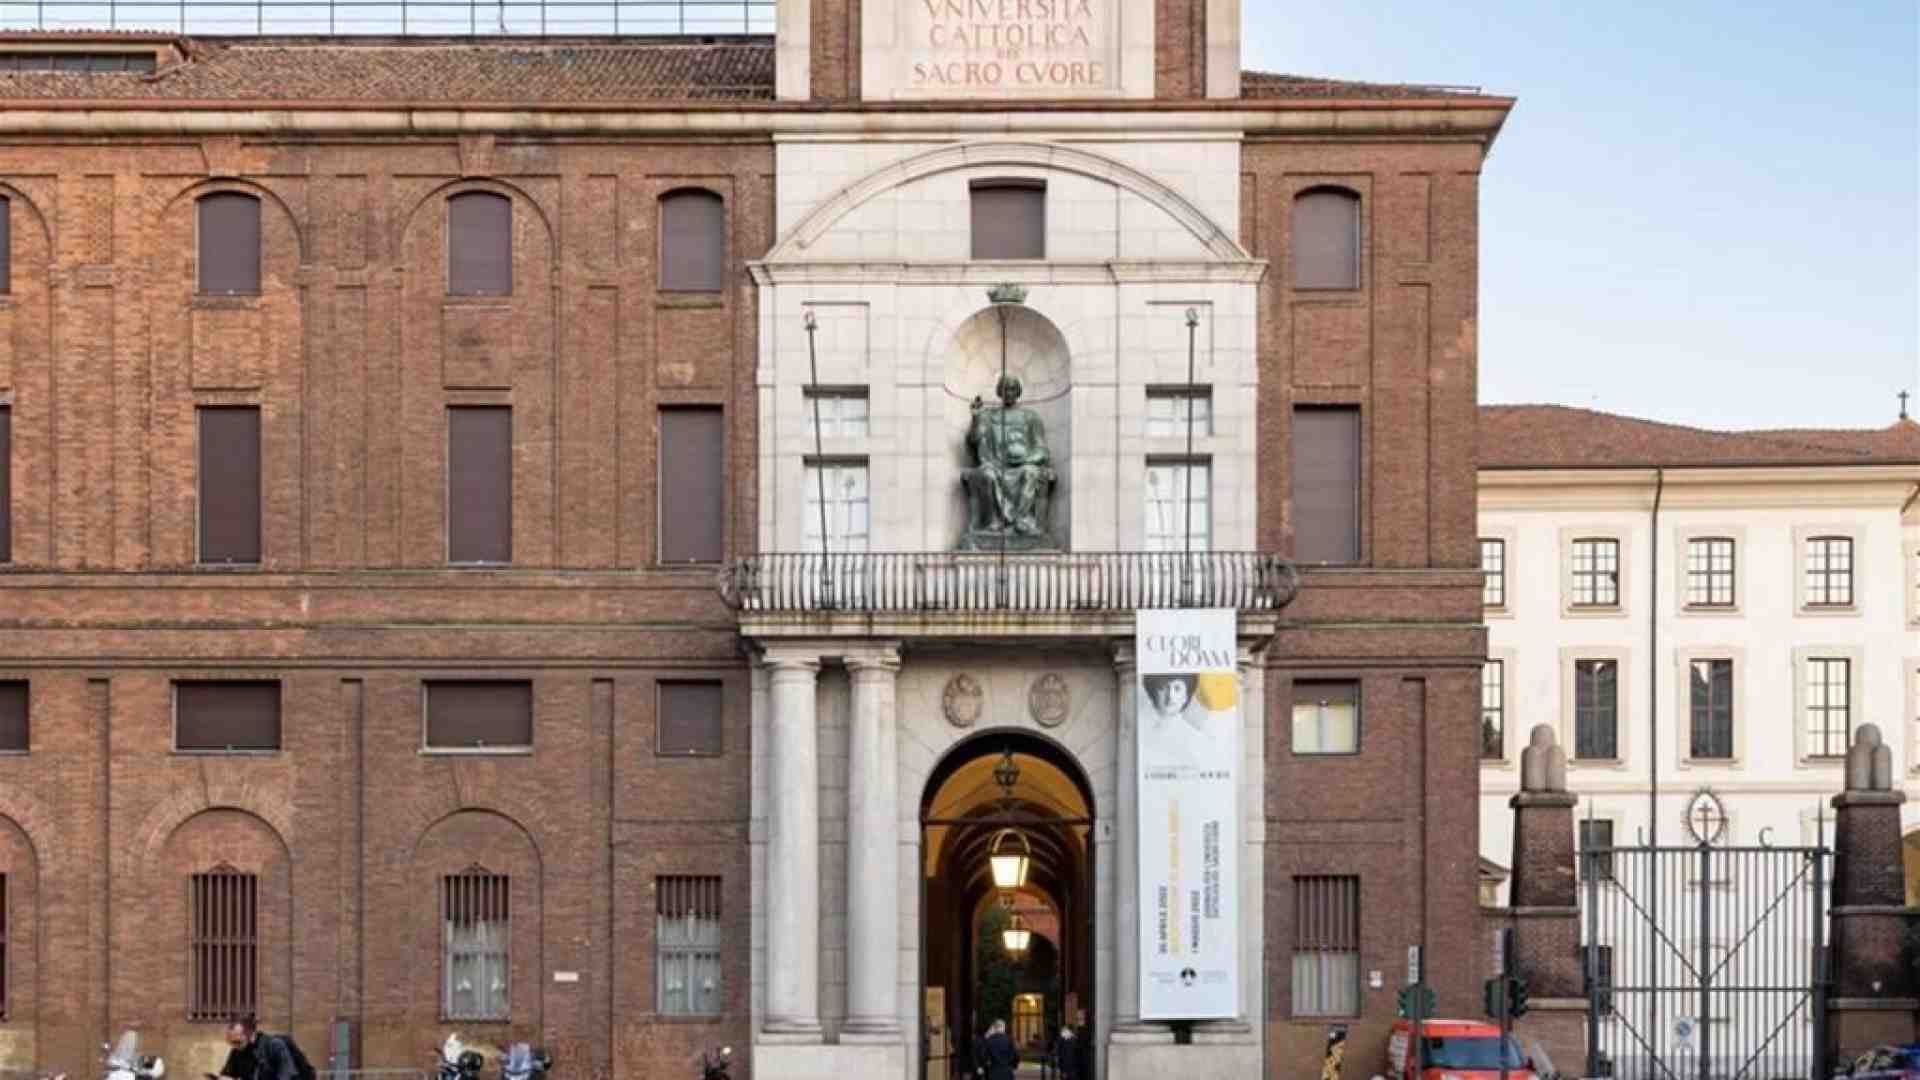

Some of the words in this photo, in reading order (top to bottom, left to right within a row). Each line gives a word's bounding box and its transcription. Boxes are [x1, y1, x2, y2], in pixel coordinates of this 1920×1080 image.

[929, 23, 1089, 46] CATTOLICA
[914, 63, 1002, 84] SACRO
[1016, 63, 1104, 84] CVORE
